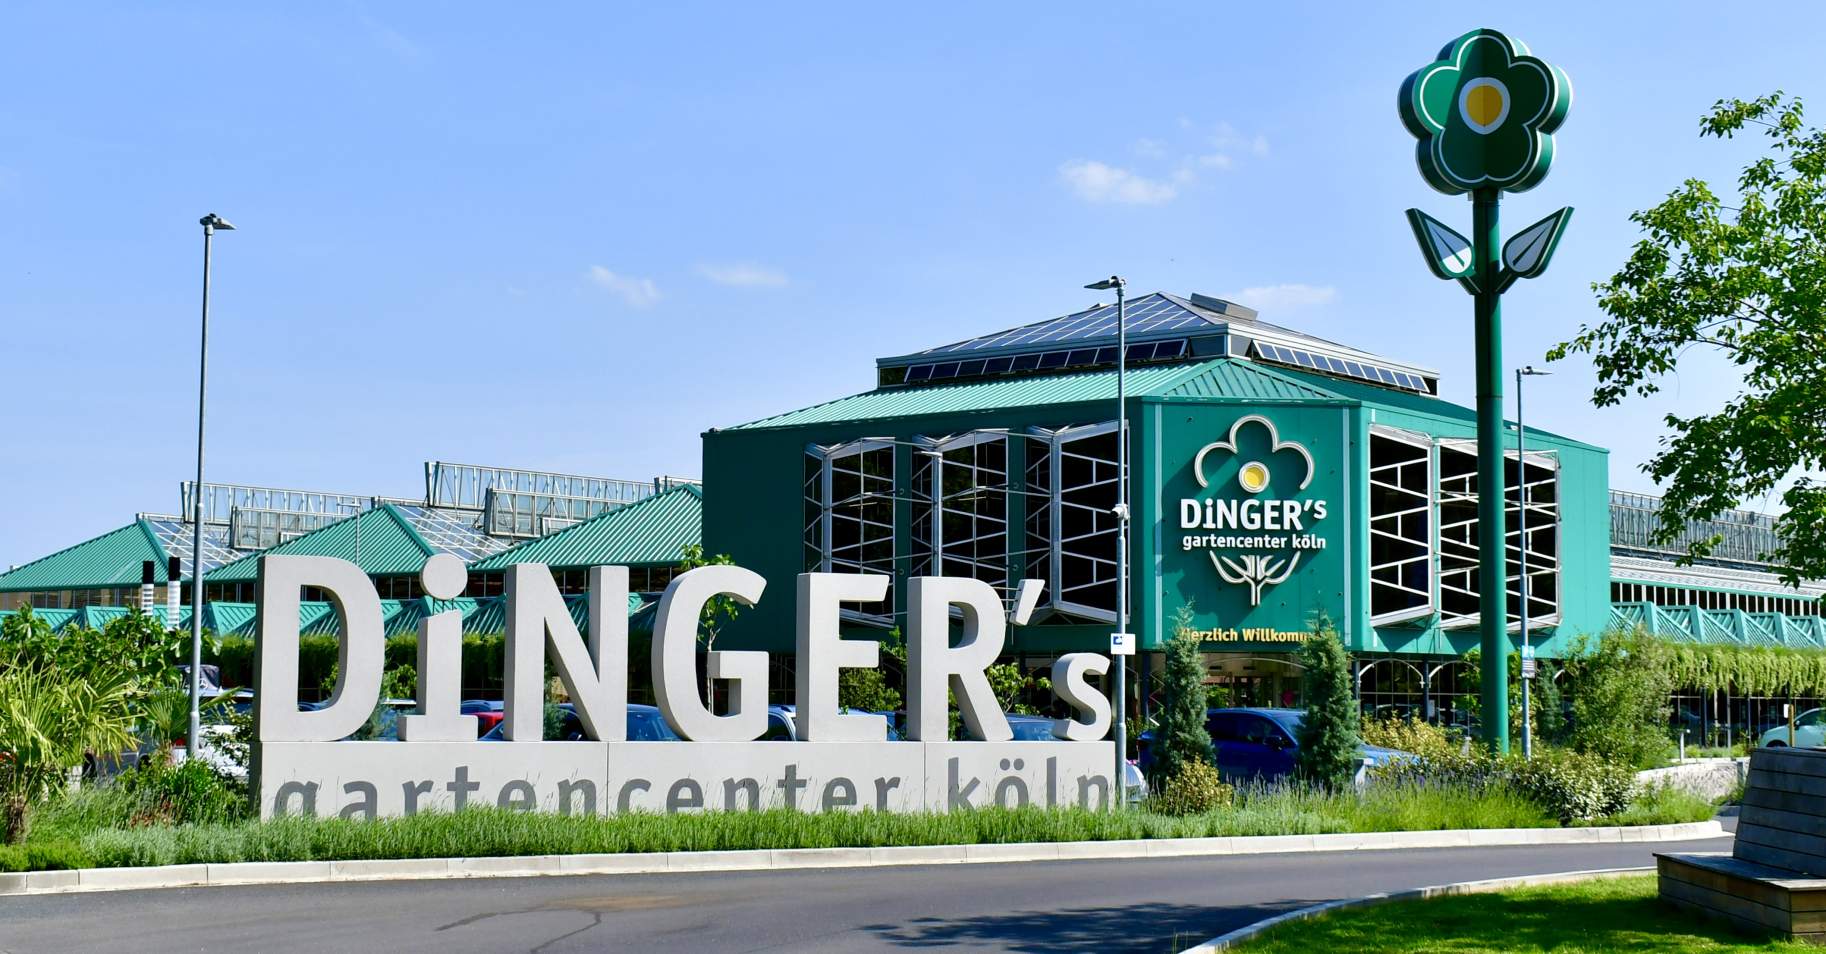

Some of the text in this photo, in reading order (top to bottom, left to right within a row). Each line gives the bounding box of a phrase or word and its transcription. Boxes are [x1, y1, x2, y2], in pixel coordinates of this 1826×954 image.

[1182, 533, 1326, 550] gartencenter köln
[948, 756, 1110, 815] köln
